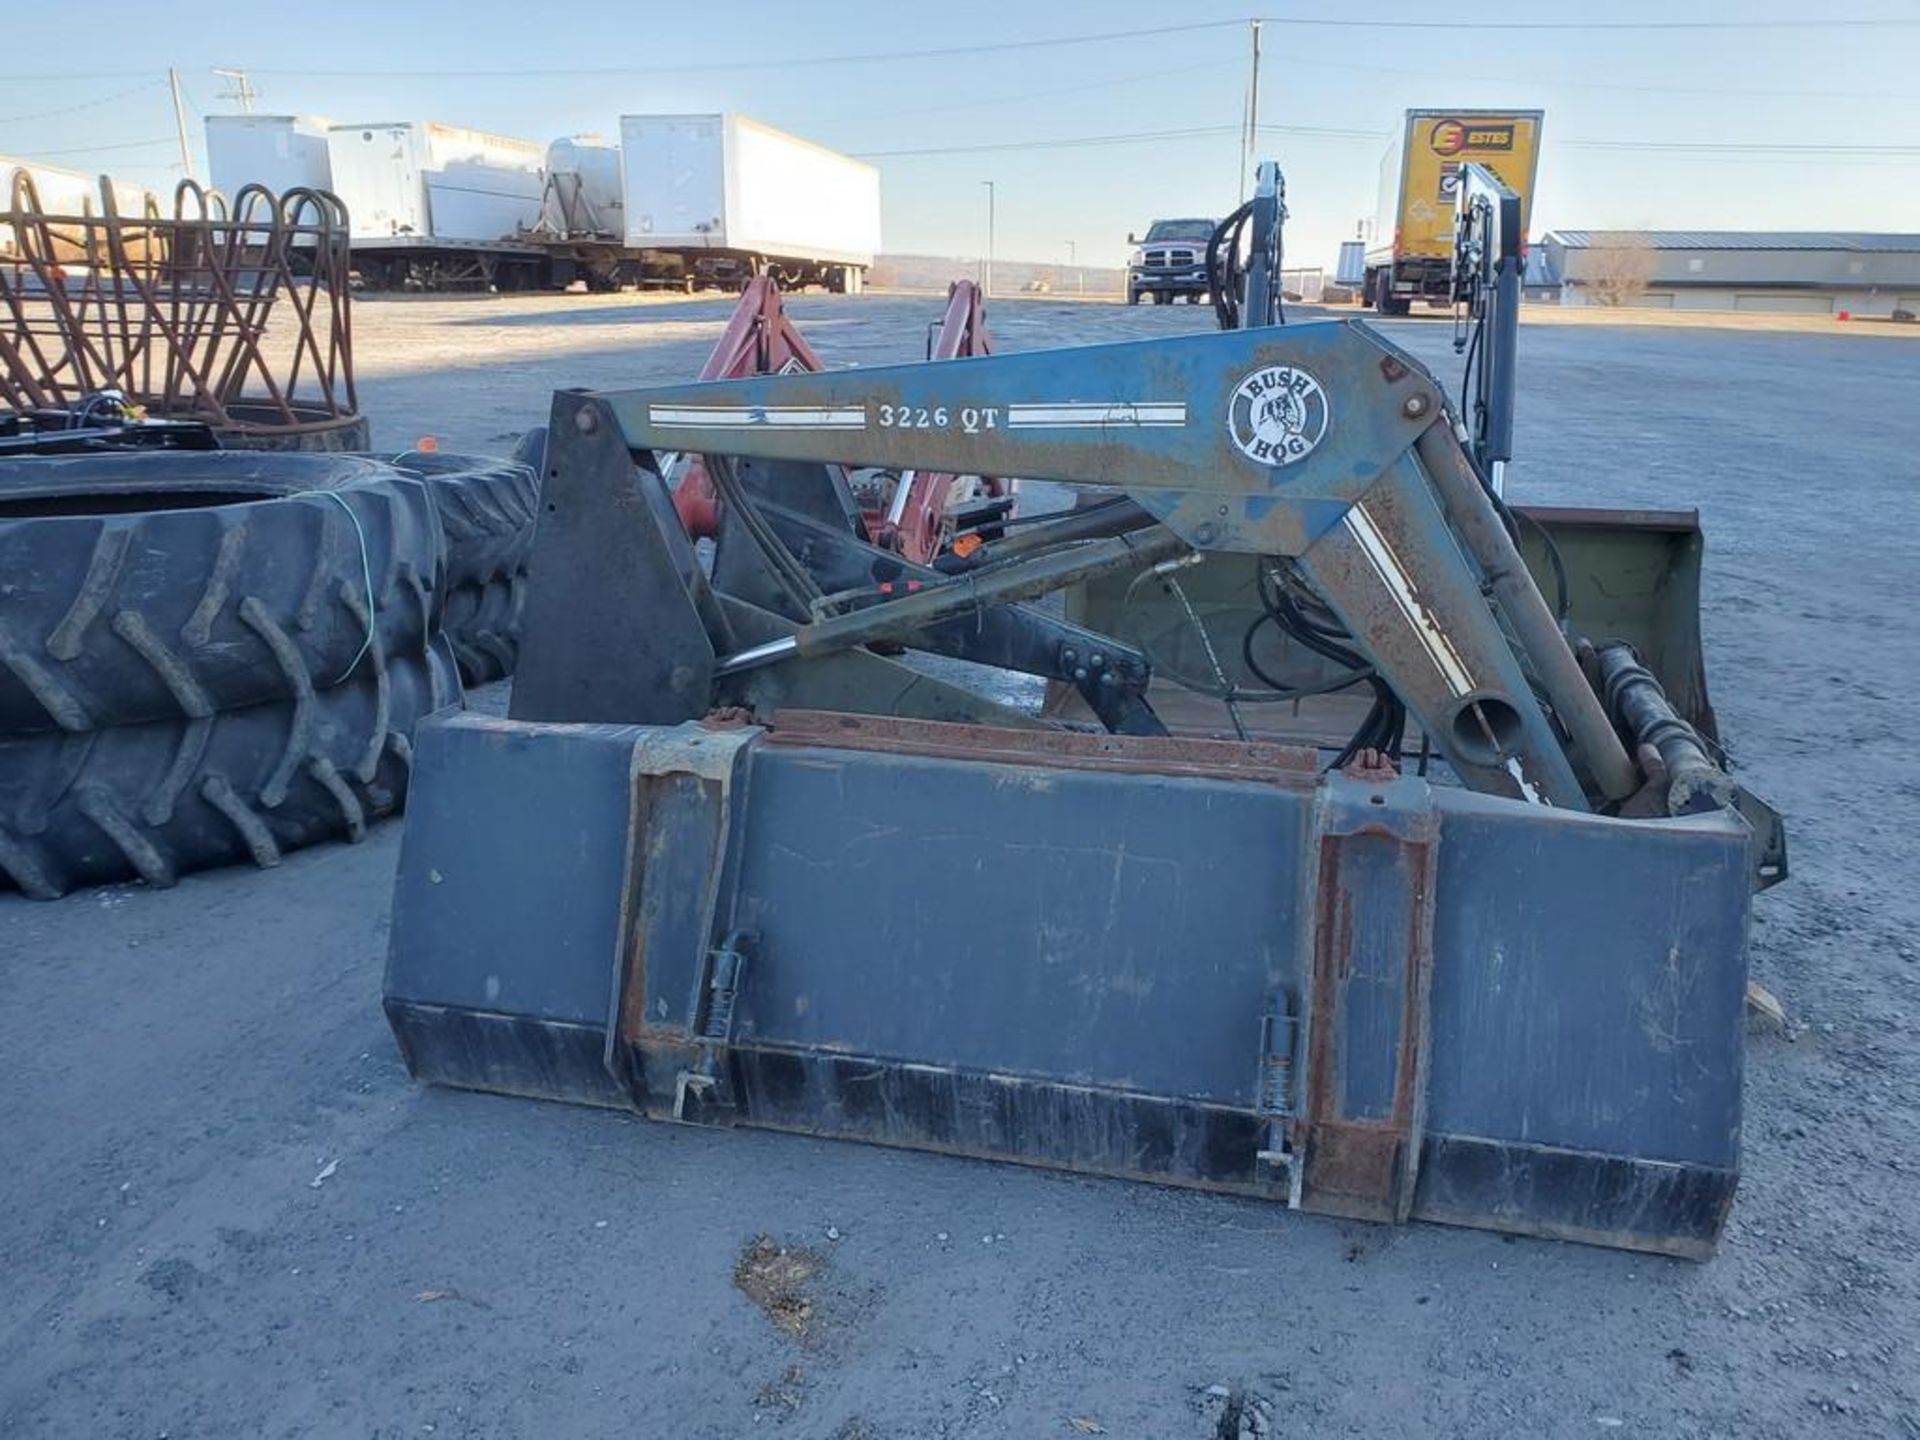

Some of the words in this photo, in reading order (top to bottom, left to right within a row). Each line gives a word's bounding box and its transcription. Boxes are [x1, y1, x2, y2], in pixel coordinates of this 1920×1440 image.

[1246, 370, 1311, 397] BUSH
[879, 404, 949, 428] 3226
[961, 407, 999, 433] QT
[1252, 438, 1305, 460] HOG
